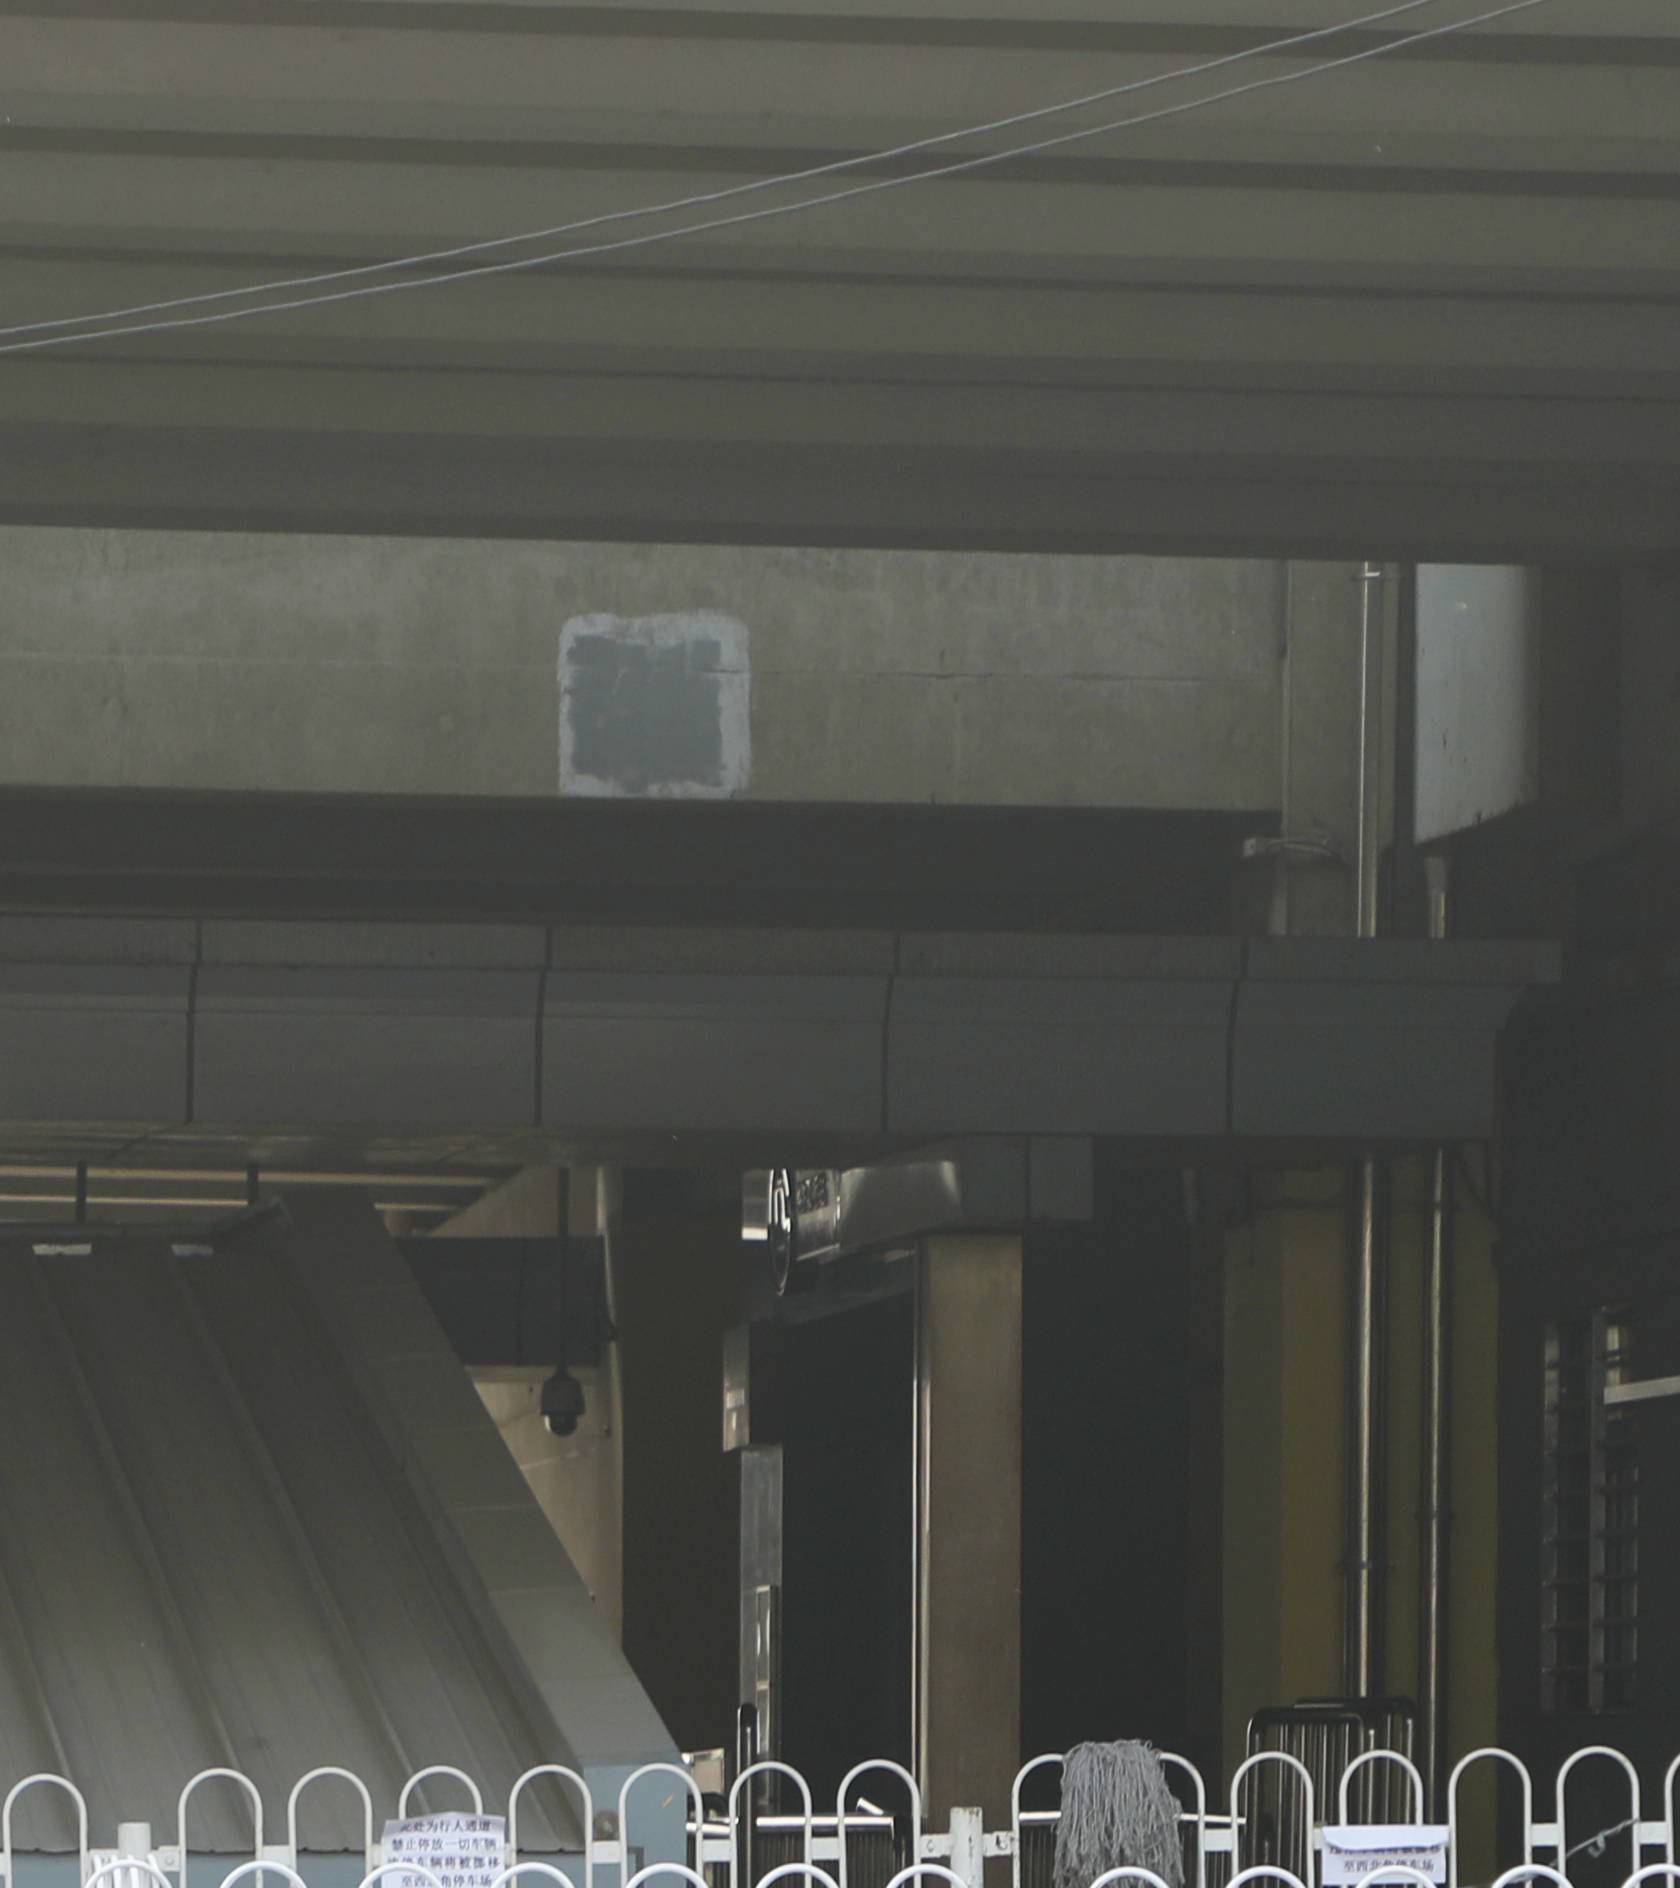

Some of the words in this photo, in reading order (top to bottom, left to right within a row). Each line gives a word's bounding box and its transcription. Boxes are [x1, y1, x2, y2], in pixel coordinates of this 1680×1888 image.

[400, 1819, 491, 1833] 此处为行人通道
[392, 1837, 497, 1852] 禁止停放一切车辆
